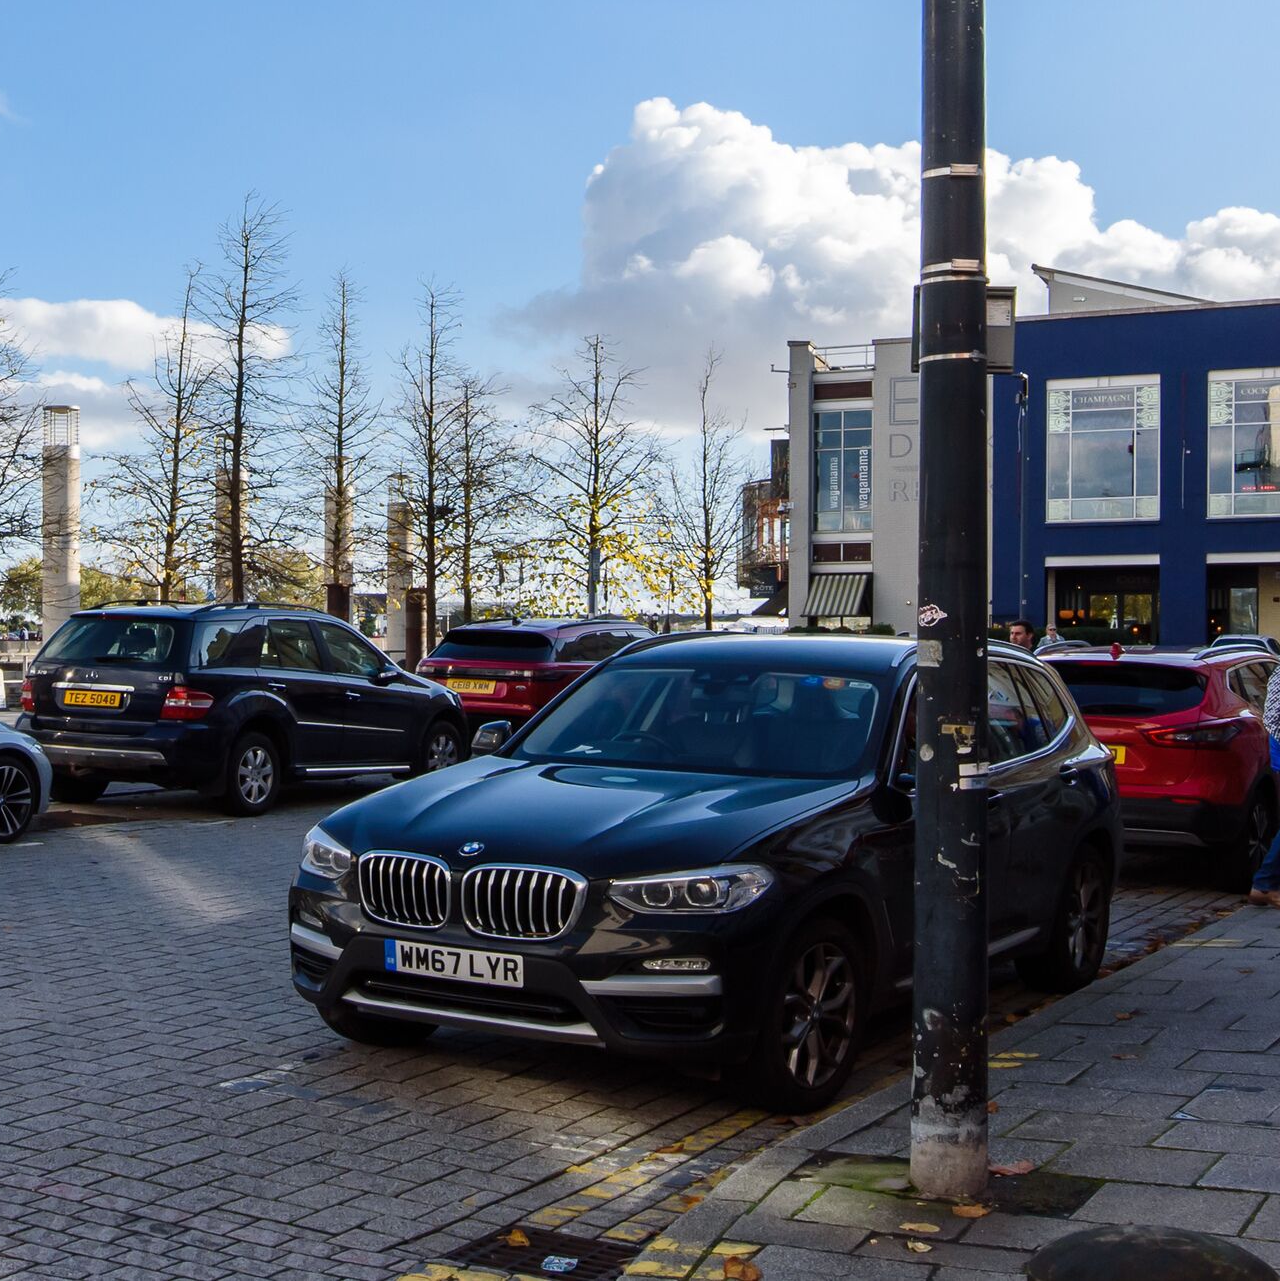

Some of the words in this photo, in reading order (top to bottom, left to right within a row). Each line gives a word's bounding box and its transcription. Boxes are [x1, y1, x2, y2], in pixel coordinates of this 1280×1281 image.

[829, 456, 840, 509] wagamama
[859, 447, 870, 509] wagamama
[69, 692, 87, 703] TEZ
[89, 693, 116, 705] 5048
[400, 944, 461, 975] WM67
[469, 954, 519, 982] LYR
